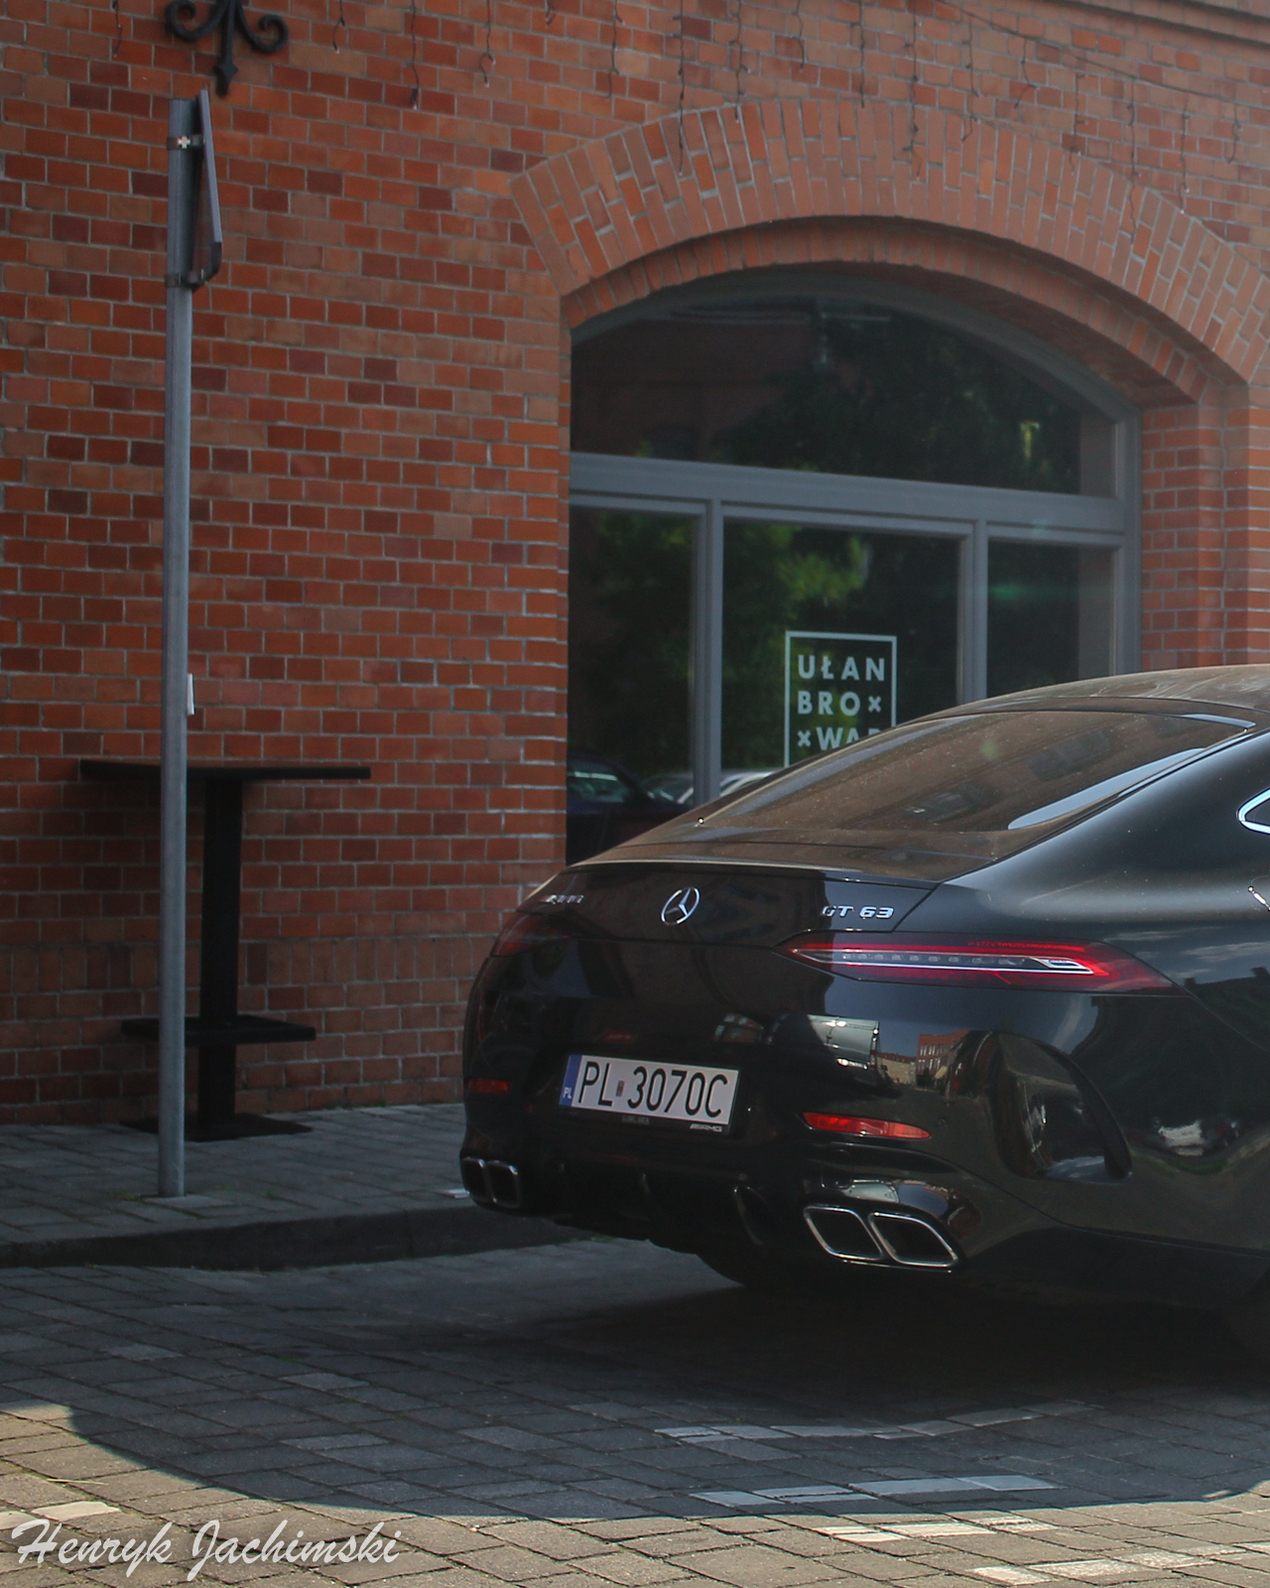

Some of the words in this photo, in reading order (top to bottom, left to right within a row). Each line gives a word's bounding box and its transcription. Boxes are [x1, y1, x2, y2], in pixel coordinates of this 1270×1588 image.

[797, 654, 885, 682] UŁAN
[816, 726, 881, 751] WA
[820, 904, 855, 918] GT
[859, 906, 895, 919] 63
[562, 1086, 573, 1100] PL
[578, 1060, 613, 1107] PL
[627, 1065, 728, 1119] 3070C
